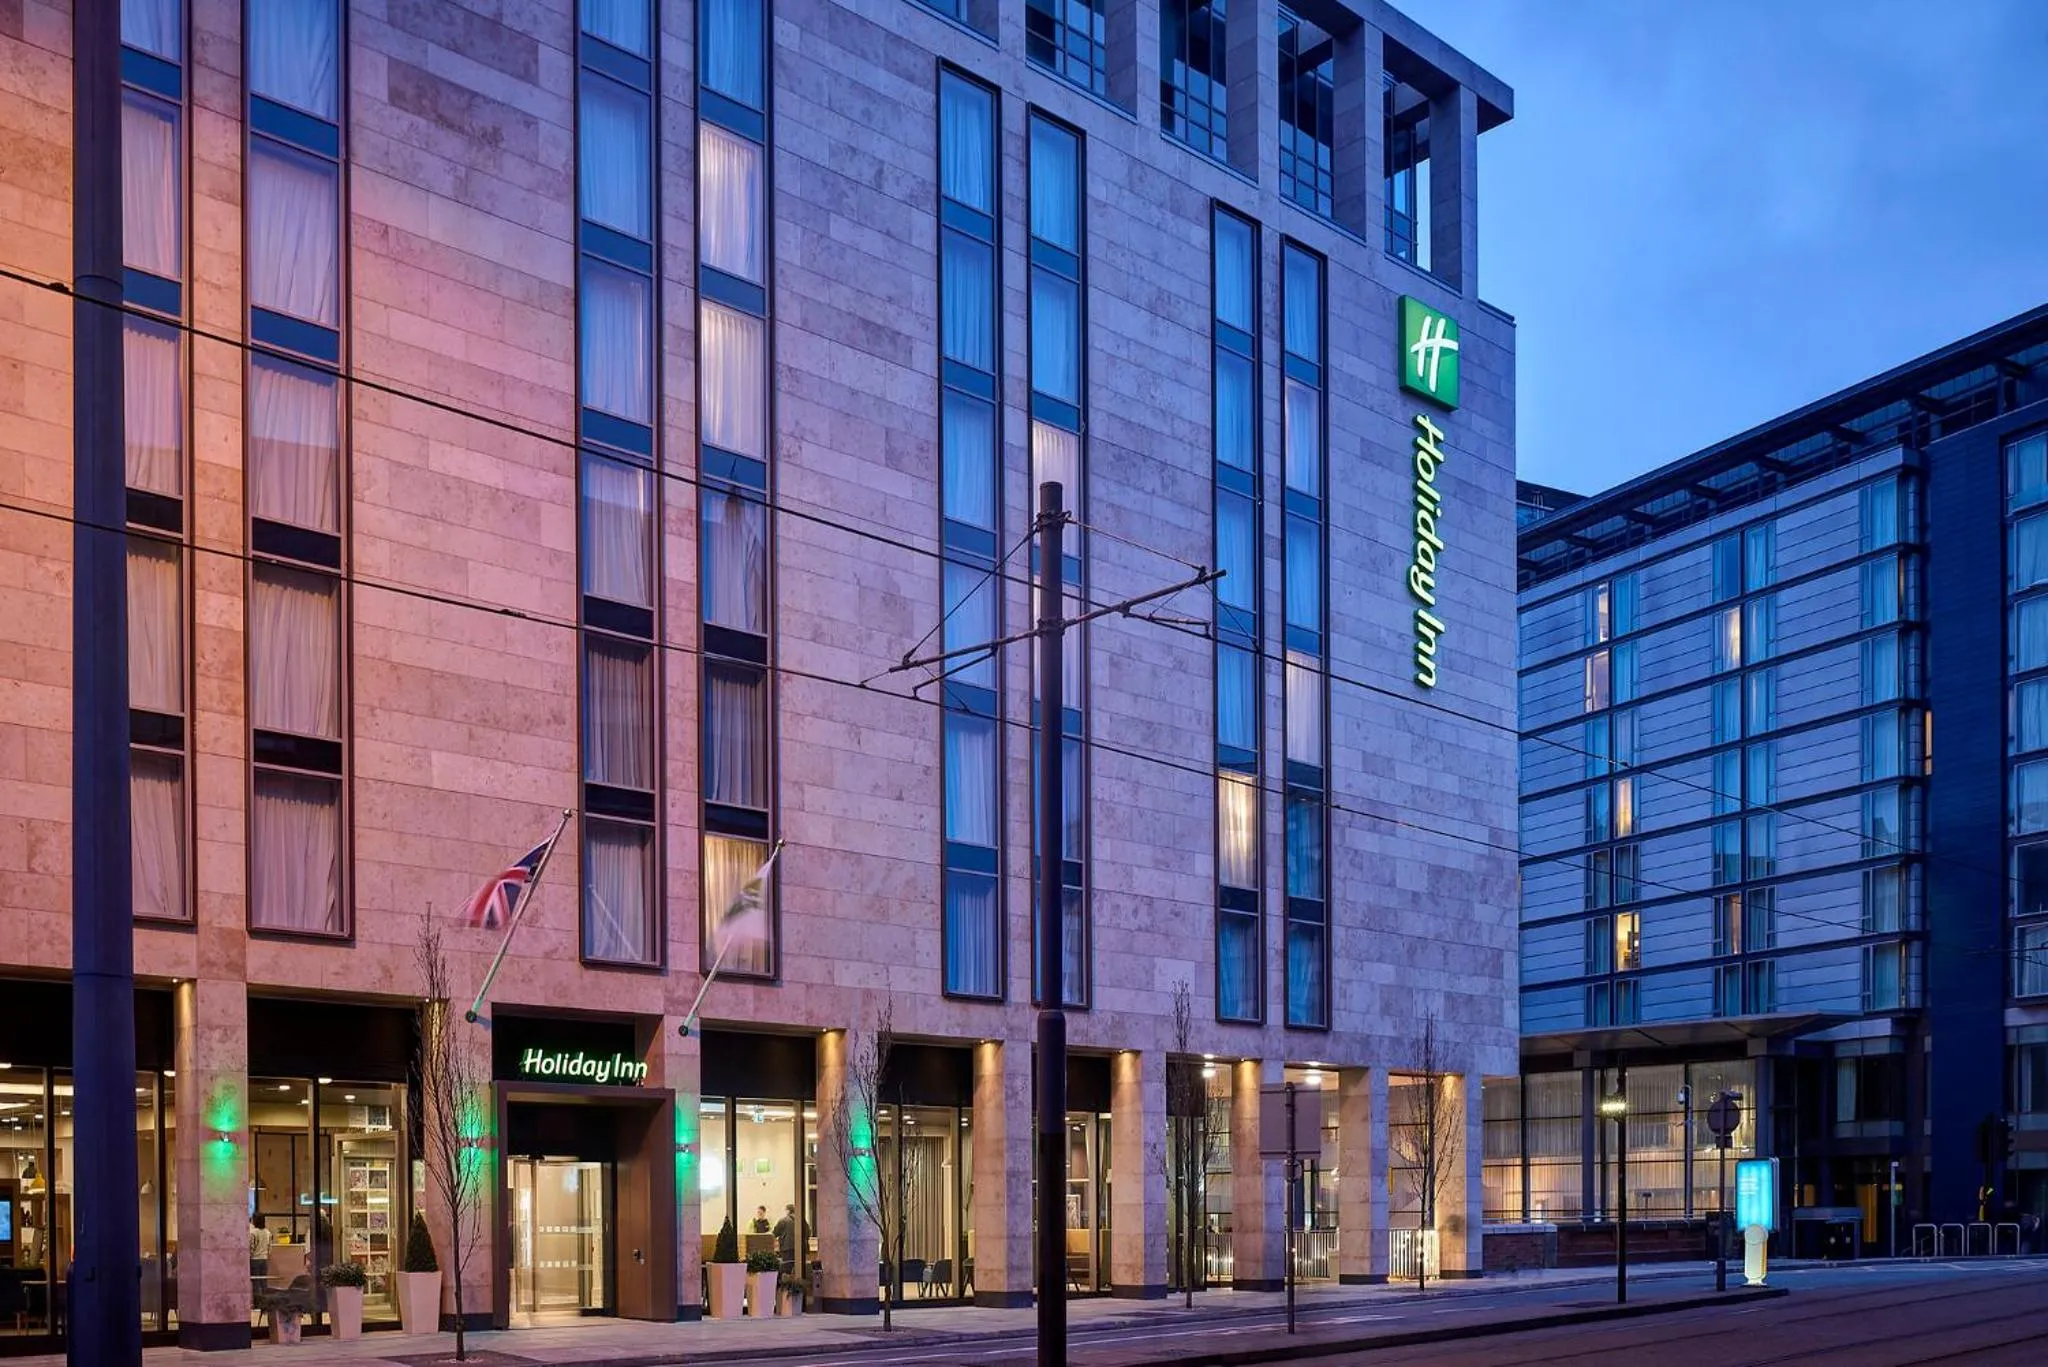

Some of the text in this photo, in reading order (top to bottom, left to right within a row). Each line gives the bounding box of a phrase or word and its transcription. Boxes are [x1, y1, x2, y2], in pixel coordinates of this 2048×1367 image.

[1409, 414, 1446, 689] Holiday Inn
[522, 1048, 648, 1083] Holiday Inn
